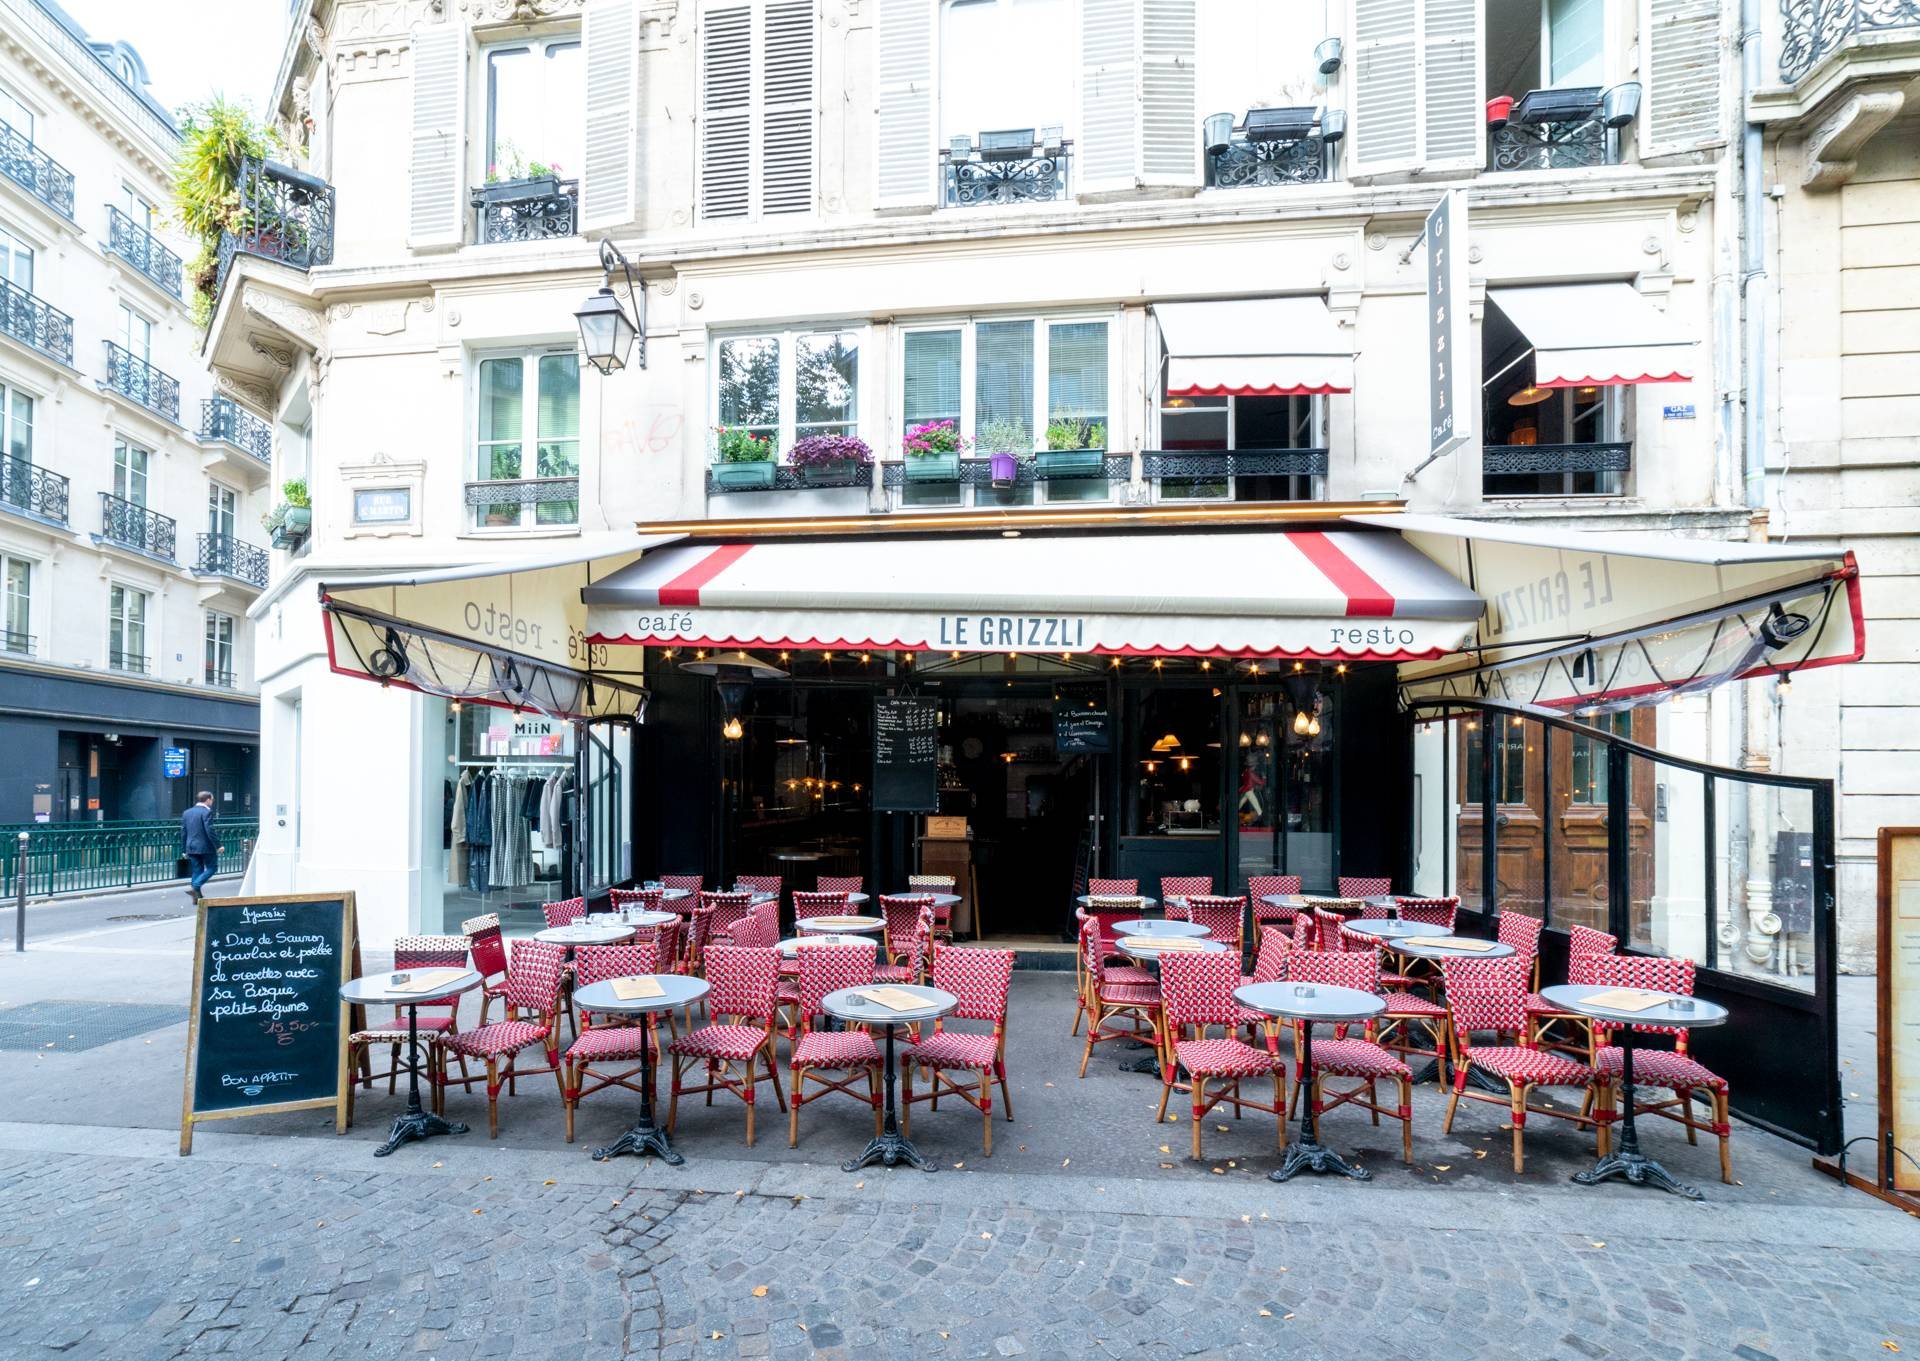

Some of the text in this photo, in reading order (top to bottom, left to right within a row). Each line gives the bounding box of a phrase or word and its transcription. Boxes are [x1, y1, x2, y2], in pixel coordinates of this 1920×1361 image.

[638, 611, 693, 633] café
[940, 617, 1083, 646] LE GRIZZLI
[1330, 625, 1415, 645] resto
[515, 722, 551, 734] MiiN
[258, 933, 273, 945] de
[275, 931, 324, 945] Saumon
[280, 946, 295, 958] et
[210, 969, 228, 982] de
[285, 968, 318, 979] avec
[208, 987, 236, 1001] sa
[210, 999, 309, 1022] petits légumes
